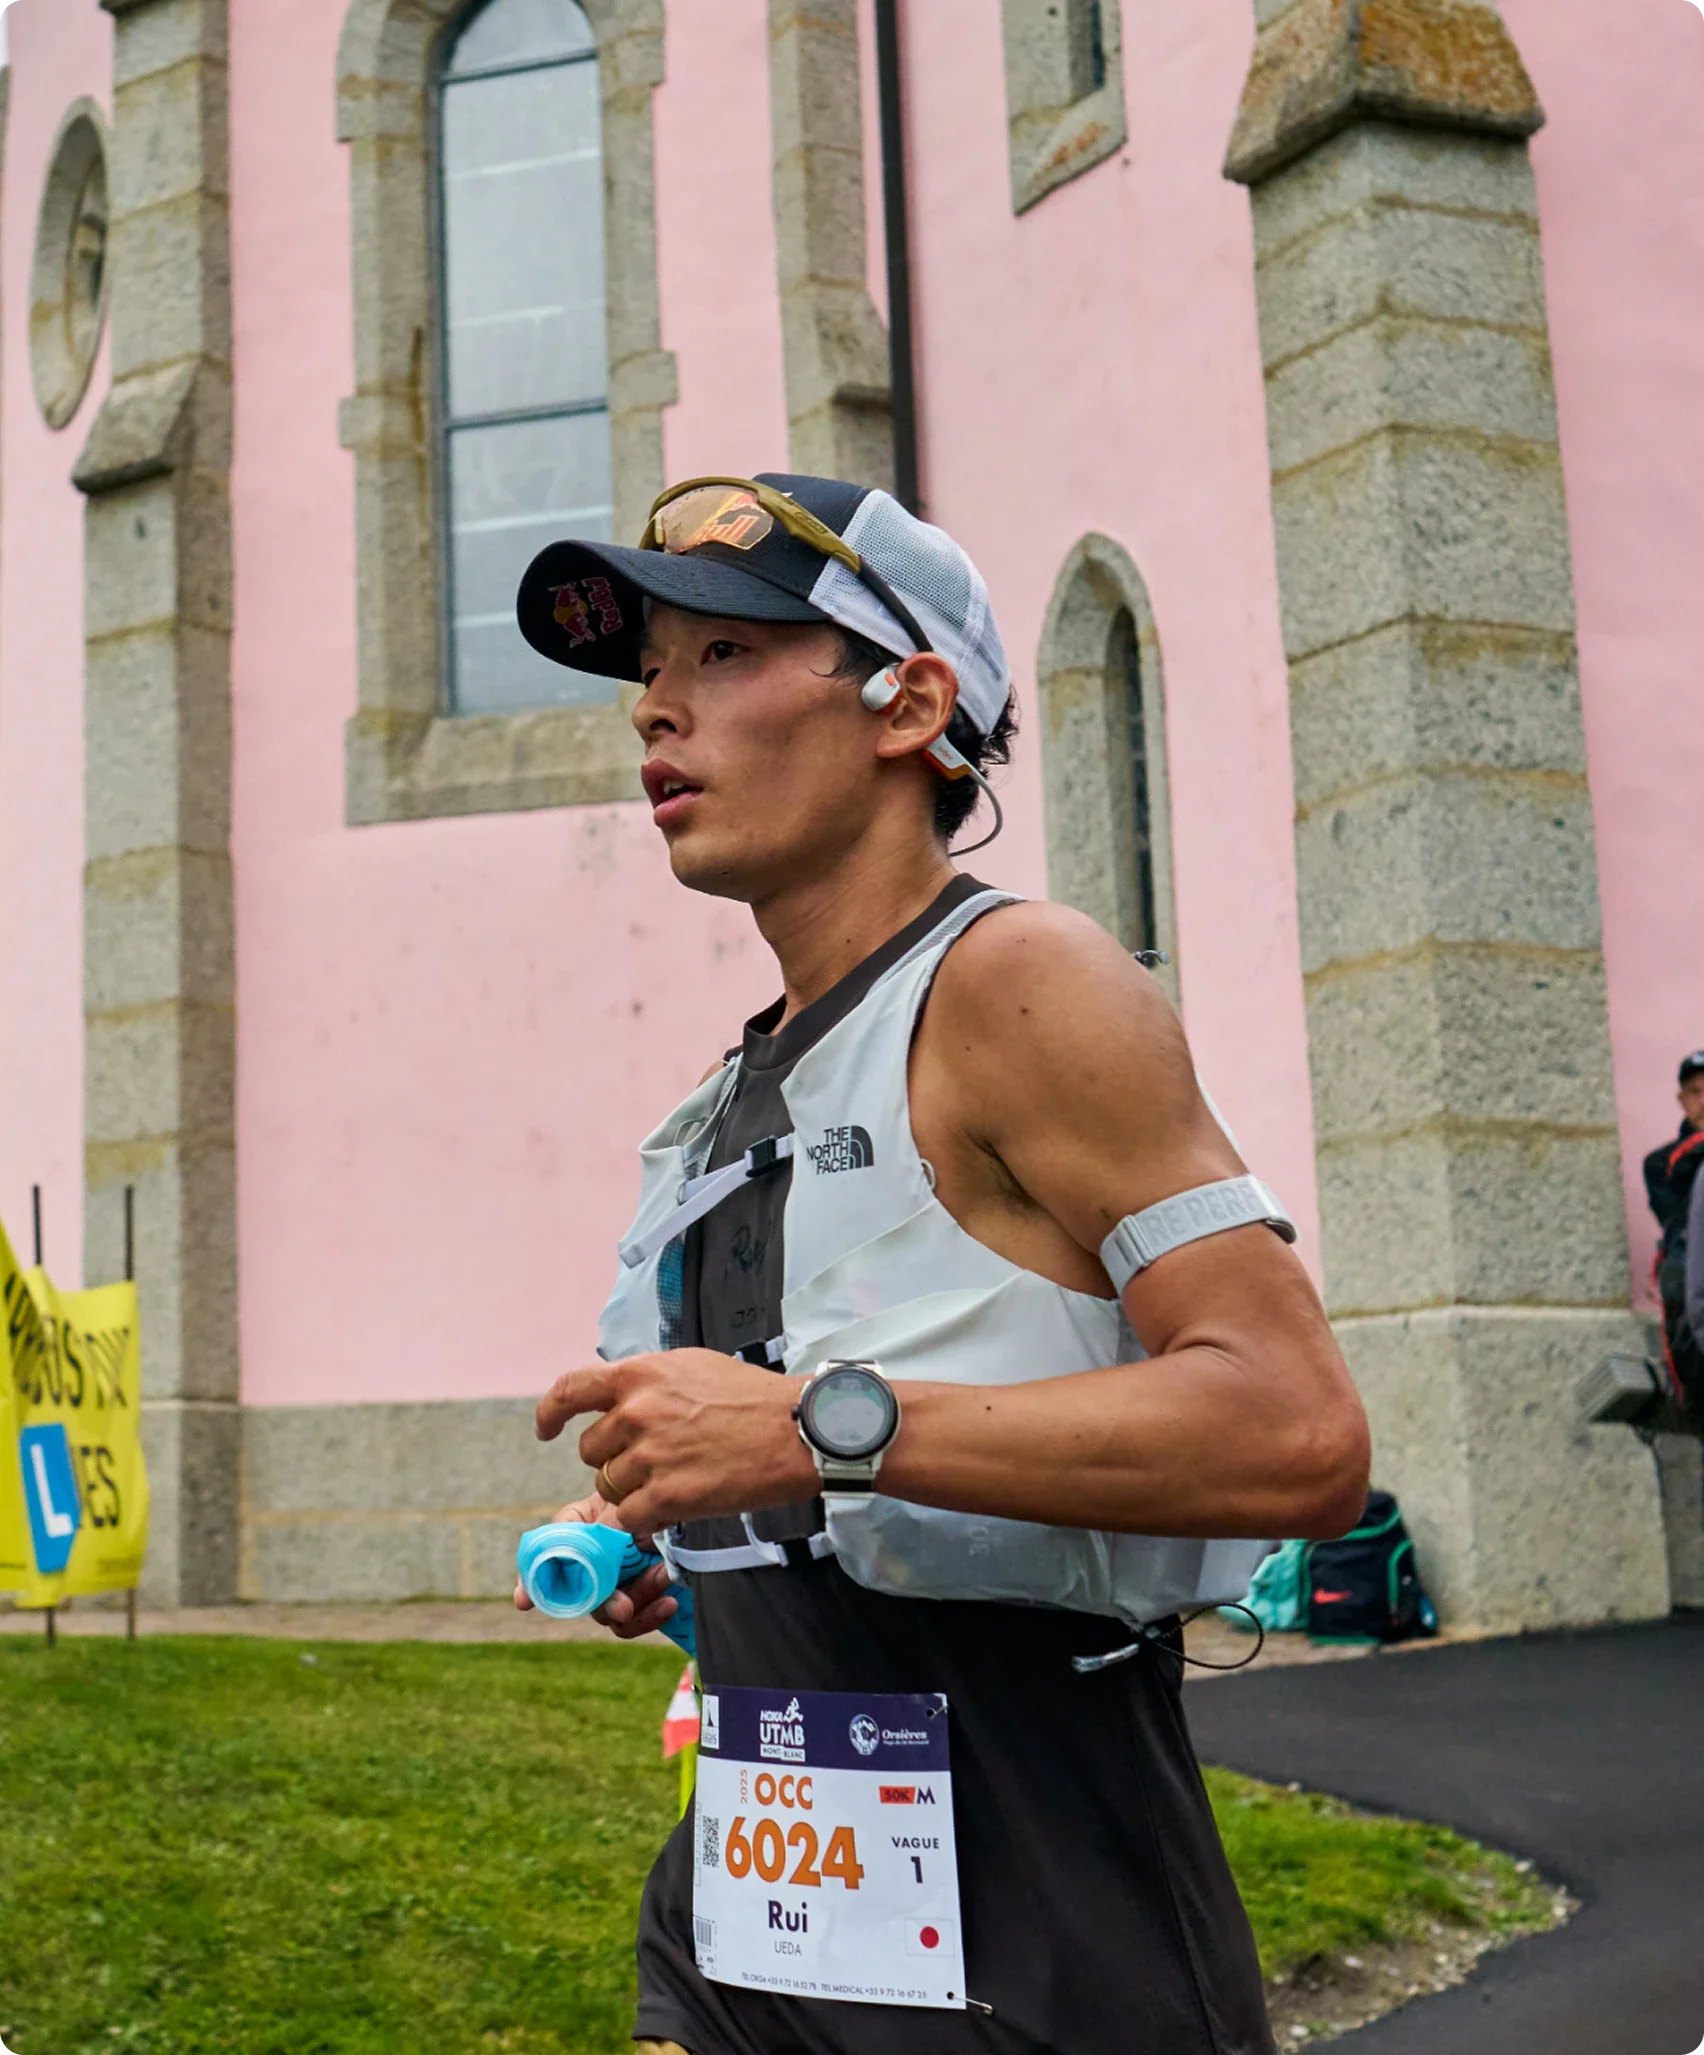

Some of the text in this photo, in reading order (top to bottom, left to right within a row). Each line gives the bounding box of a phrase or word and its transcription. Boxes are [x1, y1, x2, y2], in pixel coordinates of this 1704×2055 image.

[823, 1126, 849, 1144] THE
[806, 1141, 849, 1162] NORTH
[816, 1157, 848, 1175] FACE
[760, 1710, 783, 1722] HOKA
[760, 1723, 805, 1746] UTMB
[882, 1728, 928, 1740] Orsières
[740, 1769, 748, 1804] 2025
[755, 1772, 813, 1810] OCC
[917, 1786, 936, 1804] M
[891, 1836, 940, 1849] VAGUE
[725, 1816, 865, 1890] 6024
[911, 1856, 923, 1884] 1
[768, 1900, 808, 1933] Rui
[774, 1940, 802, 1956] UEDA
[832, 1985, 864, 1995] MEDICAL
